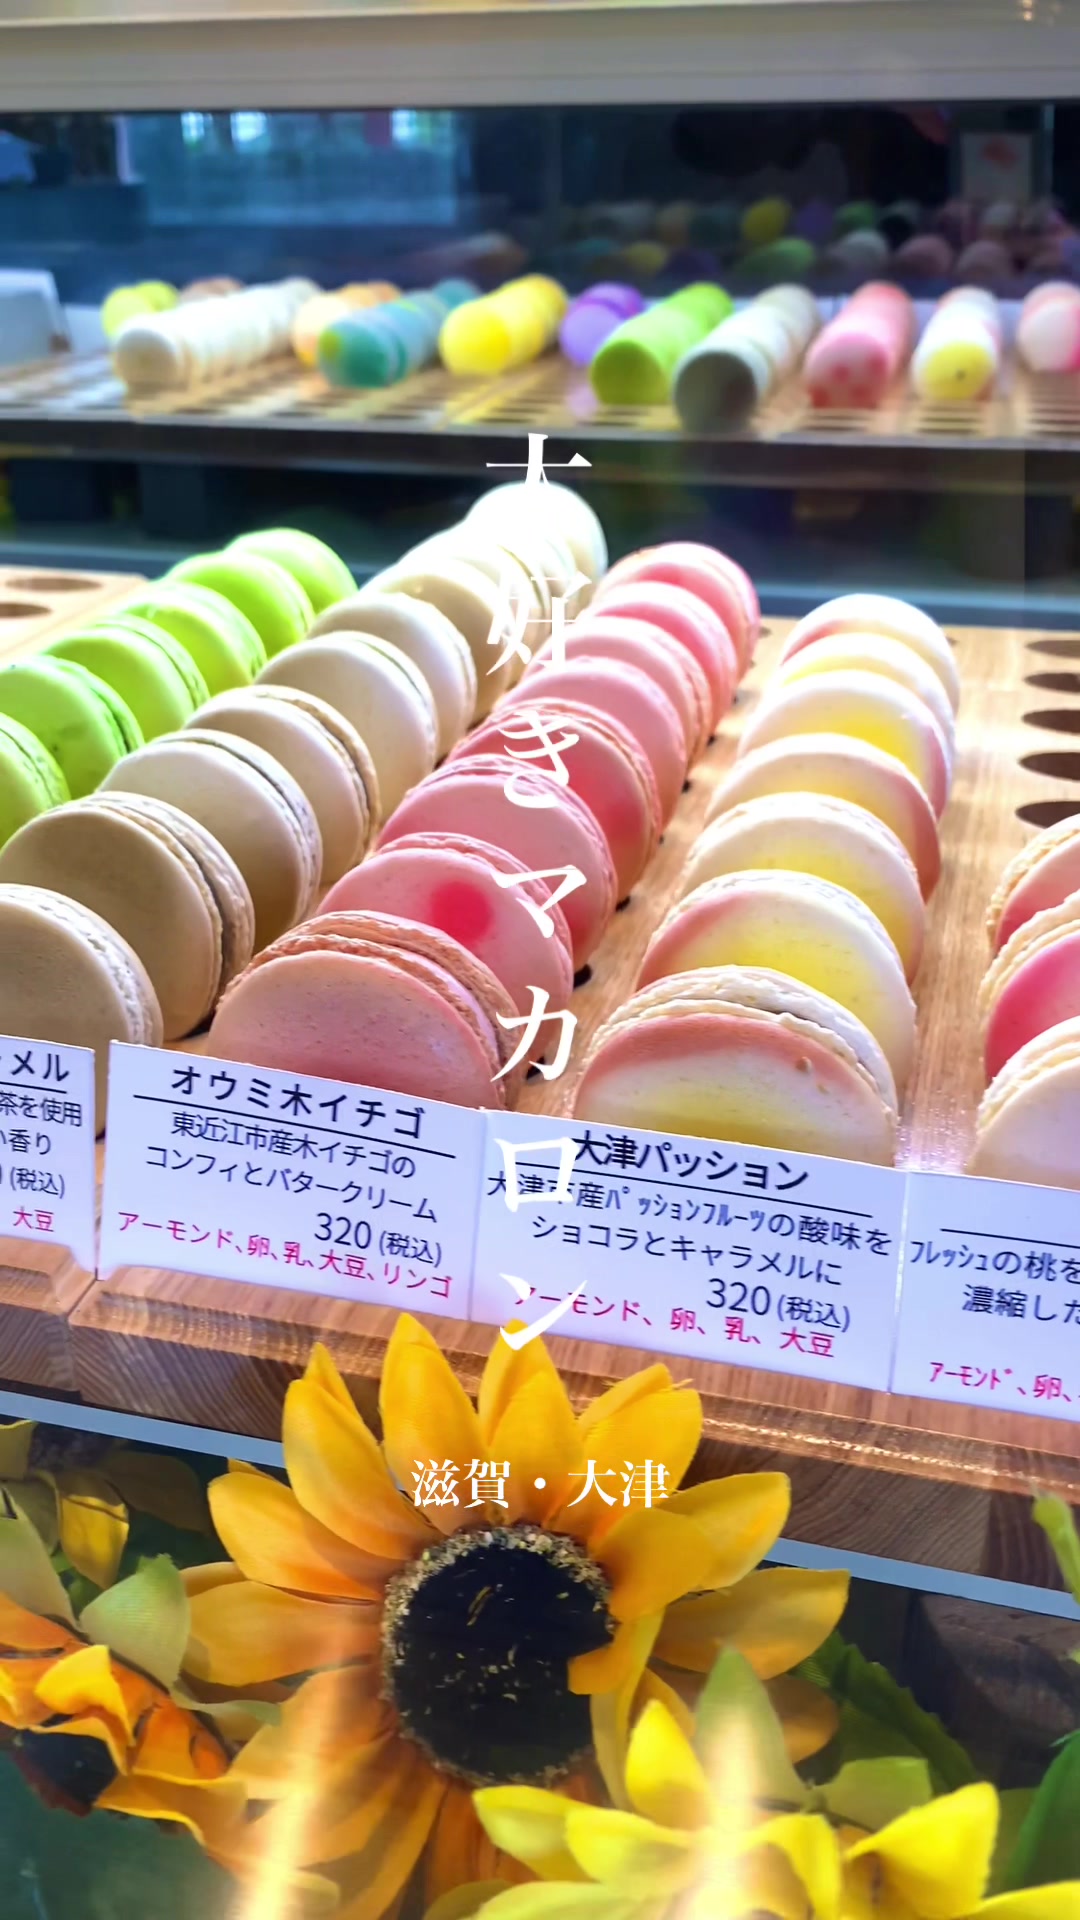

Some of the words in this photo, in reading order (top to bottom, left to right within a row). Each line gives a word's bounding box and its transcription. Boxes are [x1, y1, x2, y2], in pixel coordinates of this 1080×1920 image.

[0, 1051, 69, 1082] メル
[171, 1066, 426, 1139] オウミ木イチゴ
[171, 1111, 416, 1178] 東近江市産木イチゴの
[571, 1130, 808, 1190] 大津パッション
[146, 1146, 437, 1222] コンフィとバタークリーム
[13, 1206, 54, 1232] 大豆
[532, 1215, 842, 1285] ショコラとキャラメルに
